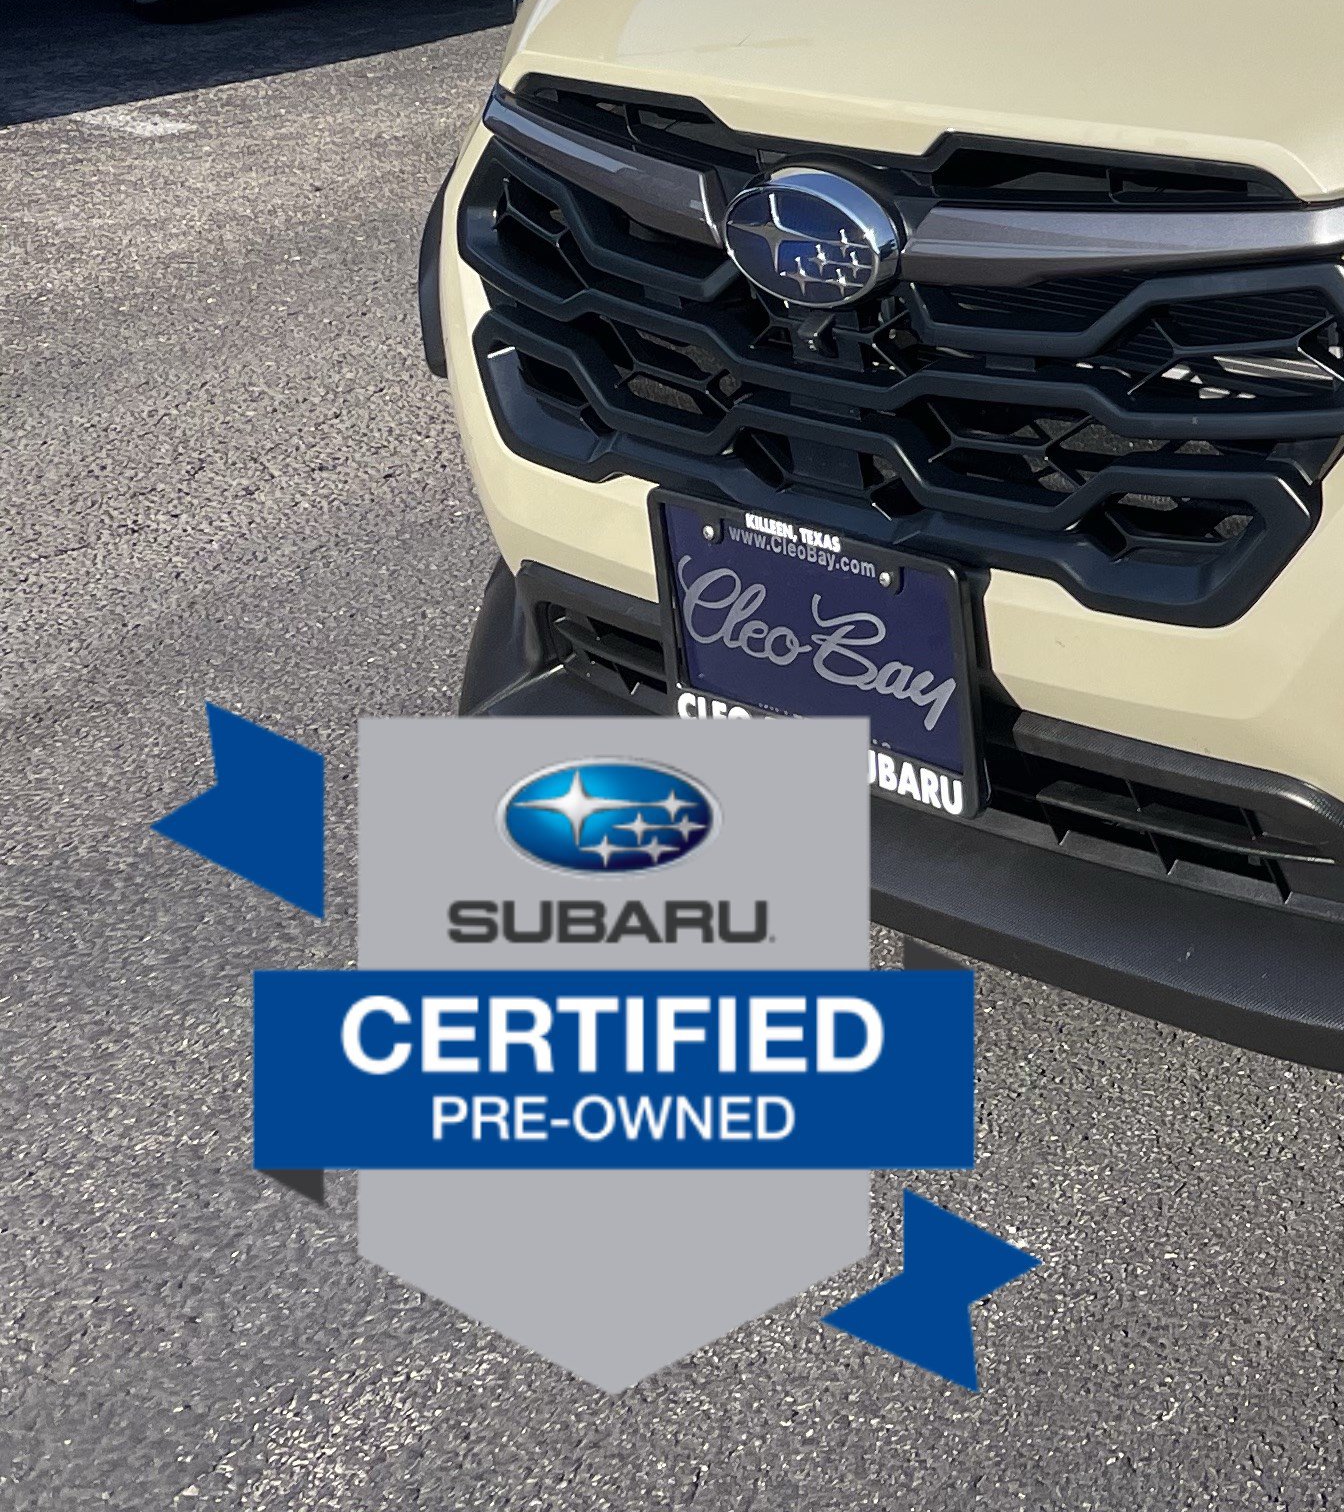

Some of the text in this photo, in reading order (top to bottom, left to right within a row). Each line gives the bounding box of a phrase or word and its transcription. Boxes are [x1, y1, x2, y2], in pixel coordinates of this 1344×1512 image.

[729, 525, 876, 577] www.CleoBay.com
[745, 512, 841, 552] KILLEEN, TEXAS
[678, 555, 957, 731] Cleo Bay
